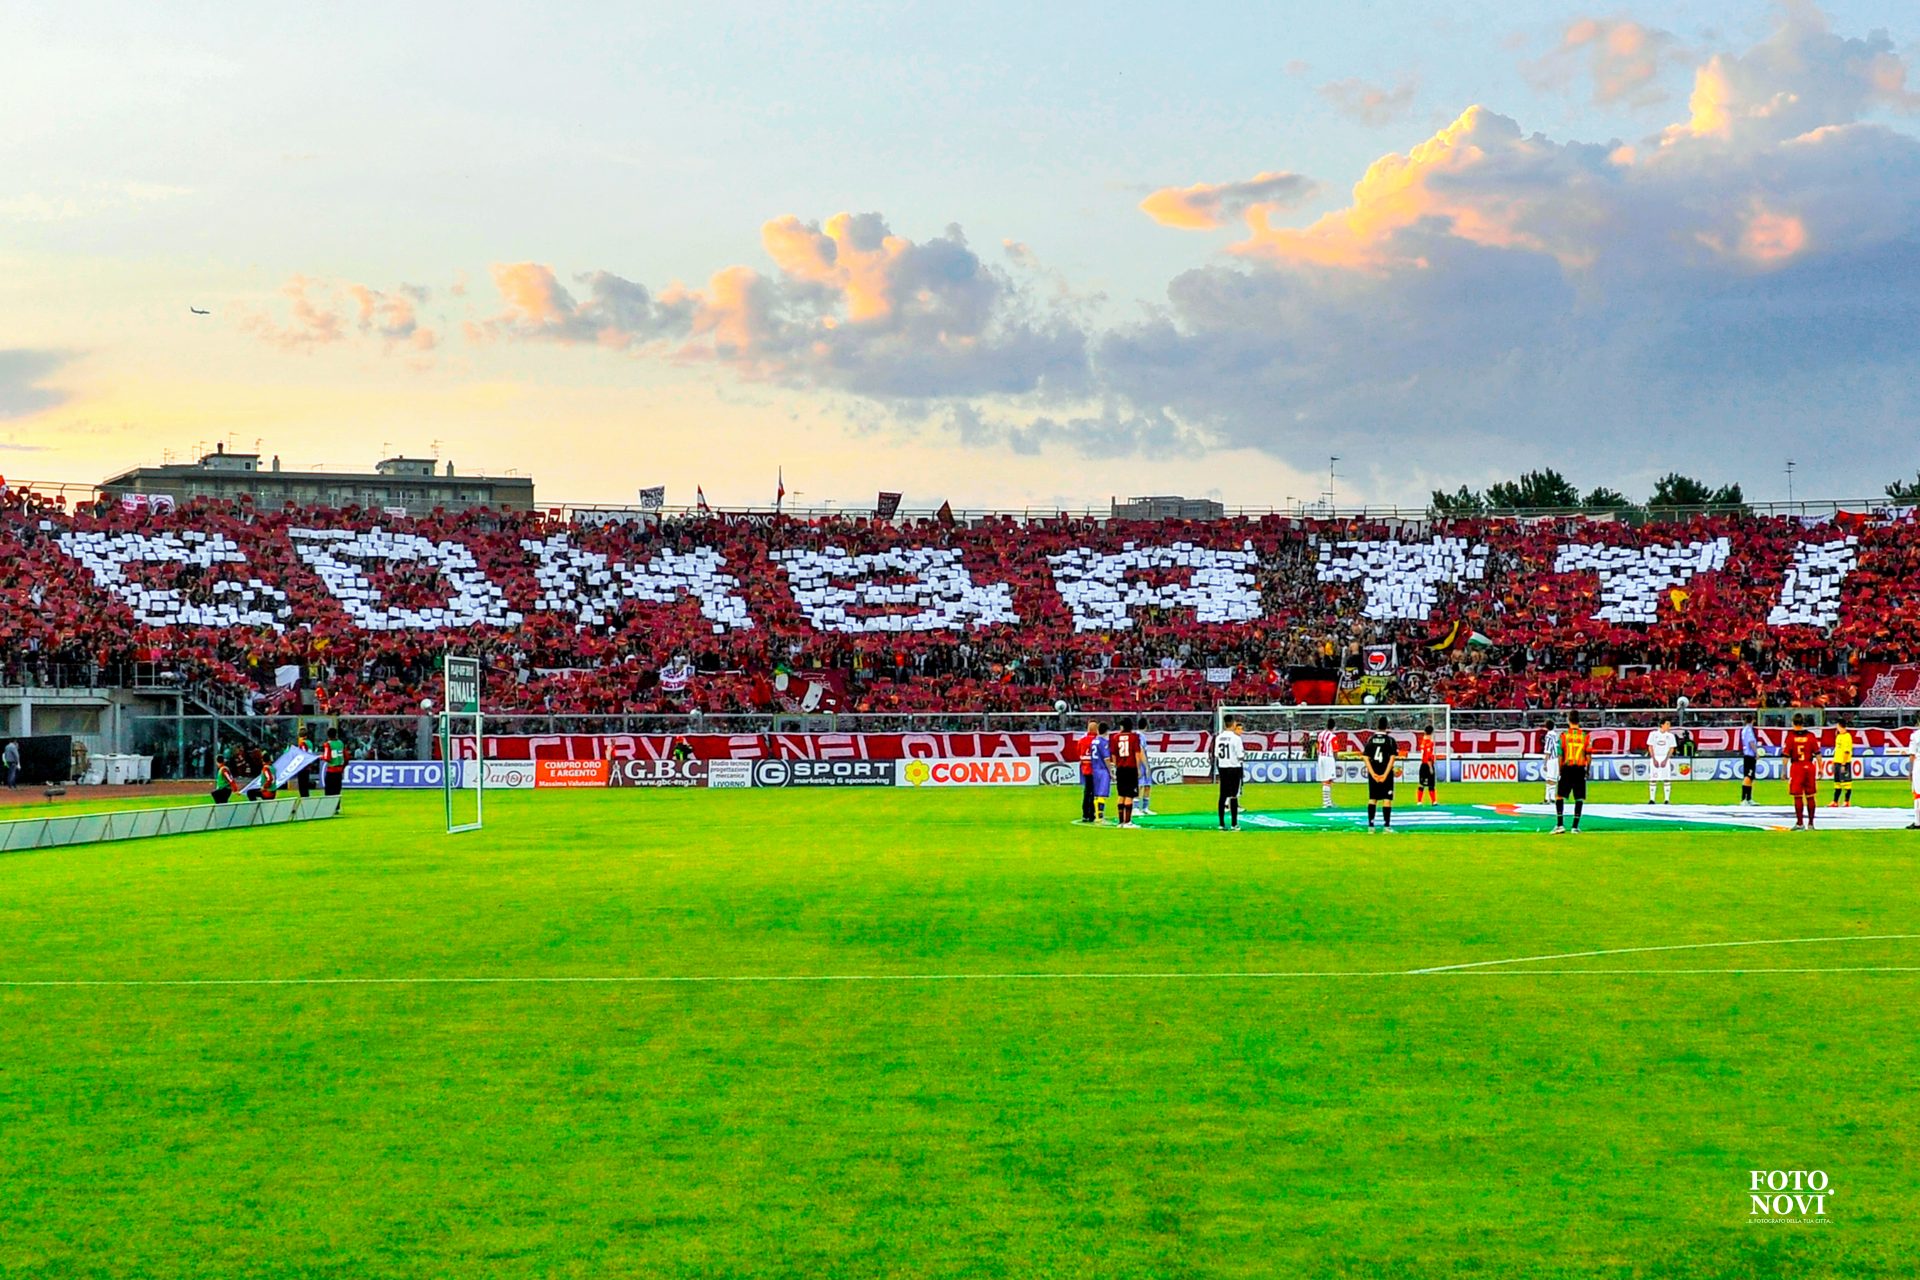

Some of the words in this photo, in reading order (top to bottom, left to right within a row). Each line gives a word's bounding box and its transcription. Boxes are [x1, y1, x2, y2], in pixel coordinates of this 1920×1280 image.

[450, 681, 475, 702] FINALE
[530, 736, 696, 760] CURV
[1118, 741, 1129, 757] 21
[1218, 742, 1230, 759] 31
[1374, 746, 1383, 763] 4
[1567, 743, 1583, 760] 17
[1797, 745, 1805, 761] 5
[544, 761, 581, 769] COMPRO
[582, 761, 602, 769] ORO
[549, 769, 556, 777] E
[557, 769, 597, 777] ARGENTO
[624, 761, 708, 779] G.B.C.
[794, 762, 890, 776] SPORT
[931, 762, 1031, 783] CONAD
[1462, 763, 1517, 780] LIVORNO
[341, 765, 442, 783] ISPETTO
[794, 778, 836, 786] marketing
[845, 778, 890, 786] sponsoring
